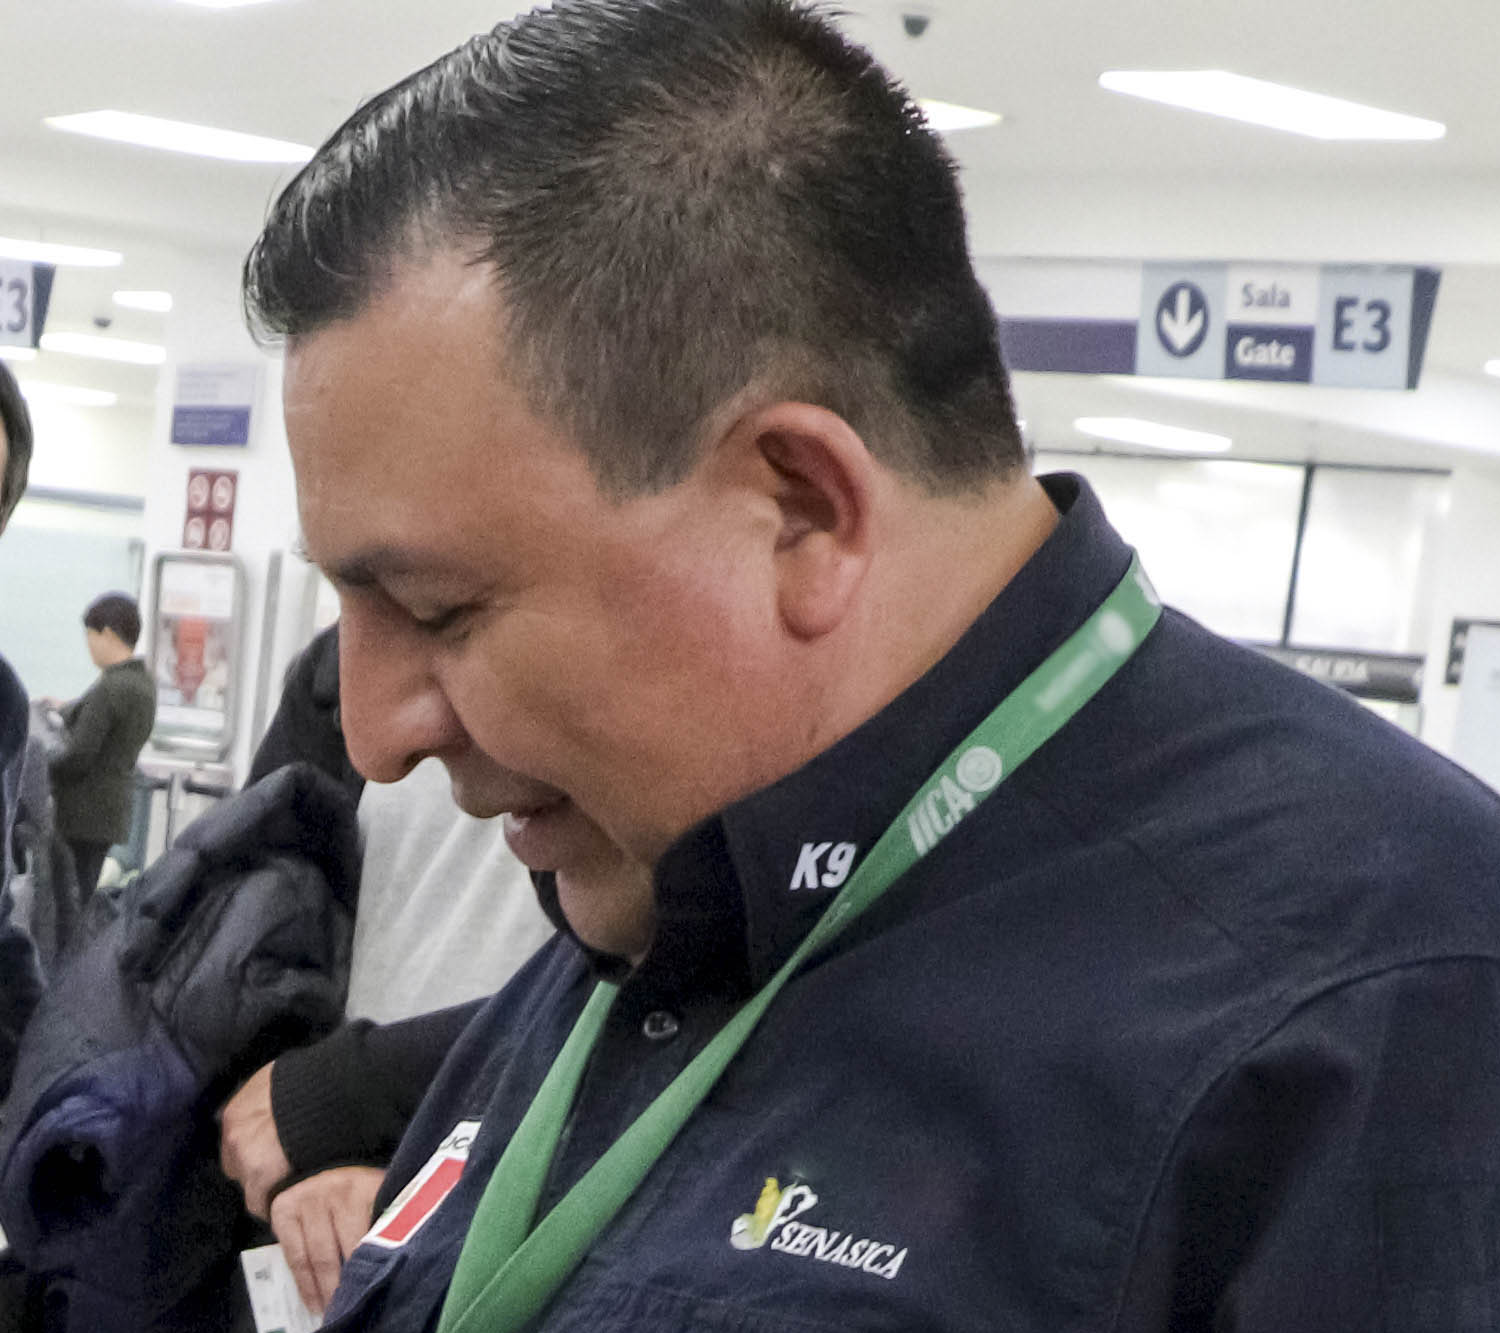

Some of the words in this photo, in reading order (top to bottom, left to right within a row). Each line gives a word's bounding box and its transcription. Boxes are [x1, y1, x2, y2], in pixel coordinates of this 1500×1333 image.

[1241, 282, 1291, 308] Sala
[1332, 296, 1392, 354] E3
[1235, 336, 1297, 368] Gate
[789, 841, 857, 890] K9
[771, 1221, 908, 1280] SENASICA
